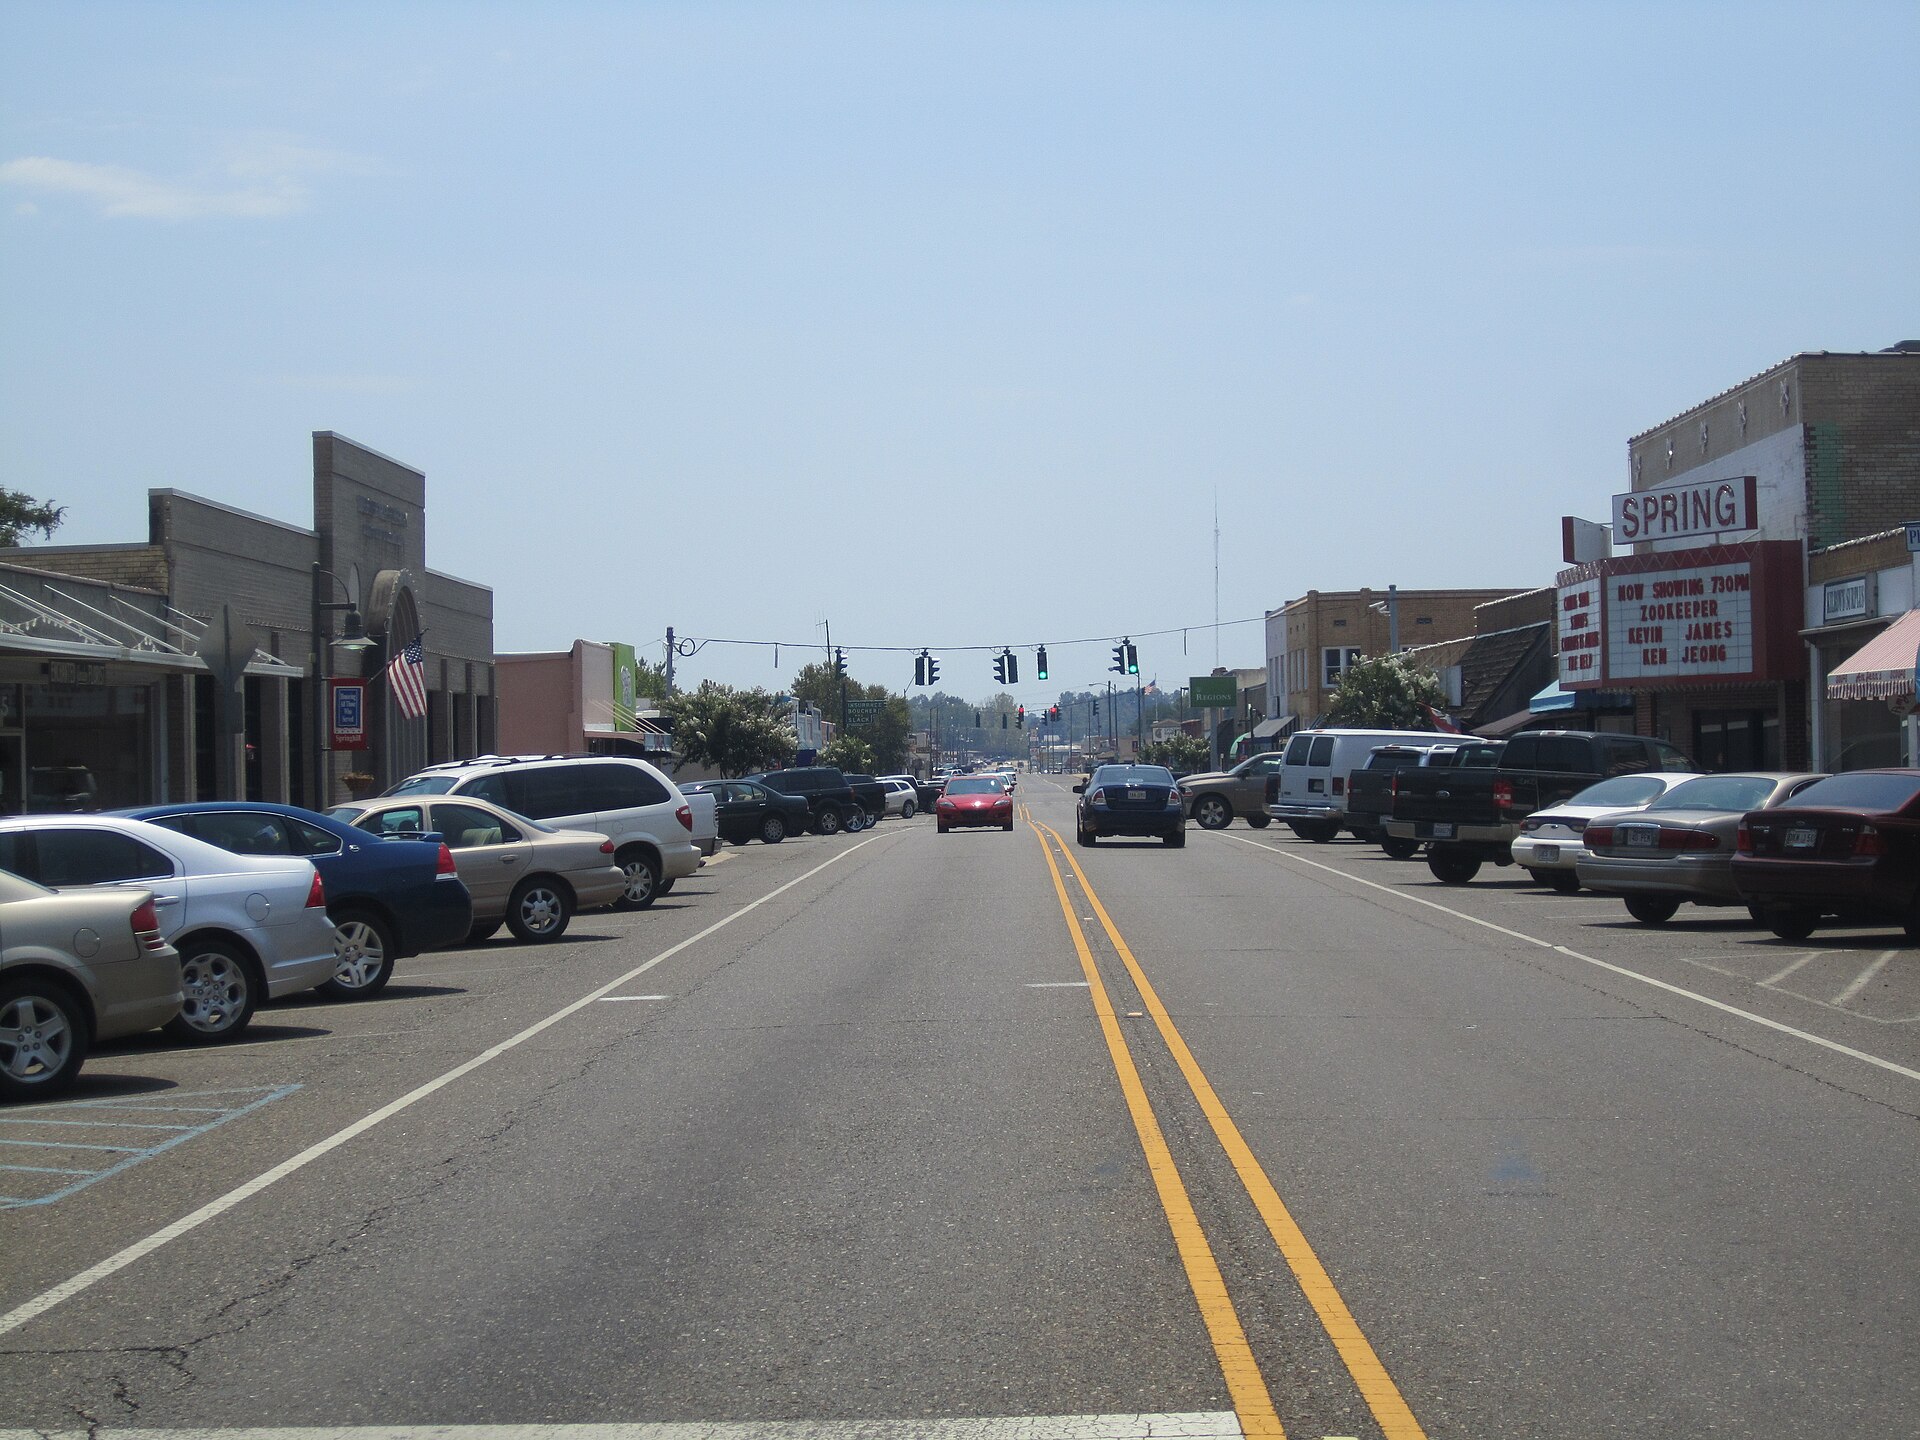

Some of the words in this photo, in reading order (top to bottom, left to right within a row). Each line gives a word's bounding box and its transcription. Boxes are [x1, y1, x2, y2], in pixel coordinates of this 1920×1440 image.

[1622, 484, 1736, 538] SPRING
[1618, 583, 1644, 601] NOW
[1653, 578, 1704, 599] SHOWING
[1711, 573, 1750, 594] 730PM
[1640, 599, 1718, 622] ZOOKEEPER
[1628, 626, 1663, 644] KEVIN
[1685, 621, 1733, 641] JAMES
[1642, 648, 1668, 665] KEN
[1681, 644, 1727, 664] JEONG
